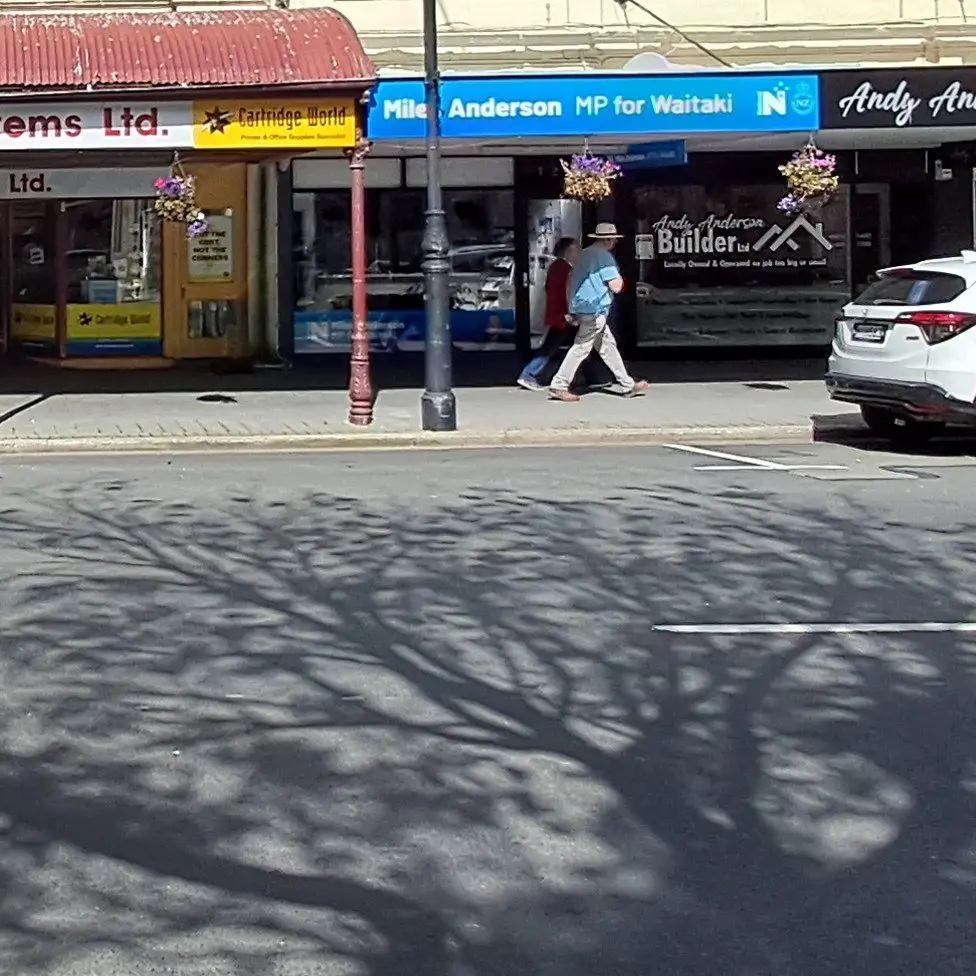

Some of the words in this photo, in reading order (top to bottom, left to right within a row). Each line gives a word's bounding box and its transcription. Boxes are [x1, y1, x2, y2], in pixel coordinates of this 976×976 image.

[383, 97, 441, 120] Mile
[448, 97, 563, 118] Anderson
[576, 95, 608, 116] MP
[613, 94, 645, 115] for
[651, 93, 734, 114] Waitaki
[839, 80, 921, 126] Andy
[928, 81, 976, 117] An
[104, 107, 169, 136] Ltd.
[238, 106, 302, 130] Cartridge
[307, 106, 346, 127] World
[10, 173, 52, 193] Ltd.
[652, 214, 693, 237] Andy
[698, 213, 764, 232] Anderson
[657, 227, 737, 253] Builder
[737, 242, 750, 253] Ltd
[787, 258, 798, 268] big
